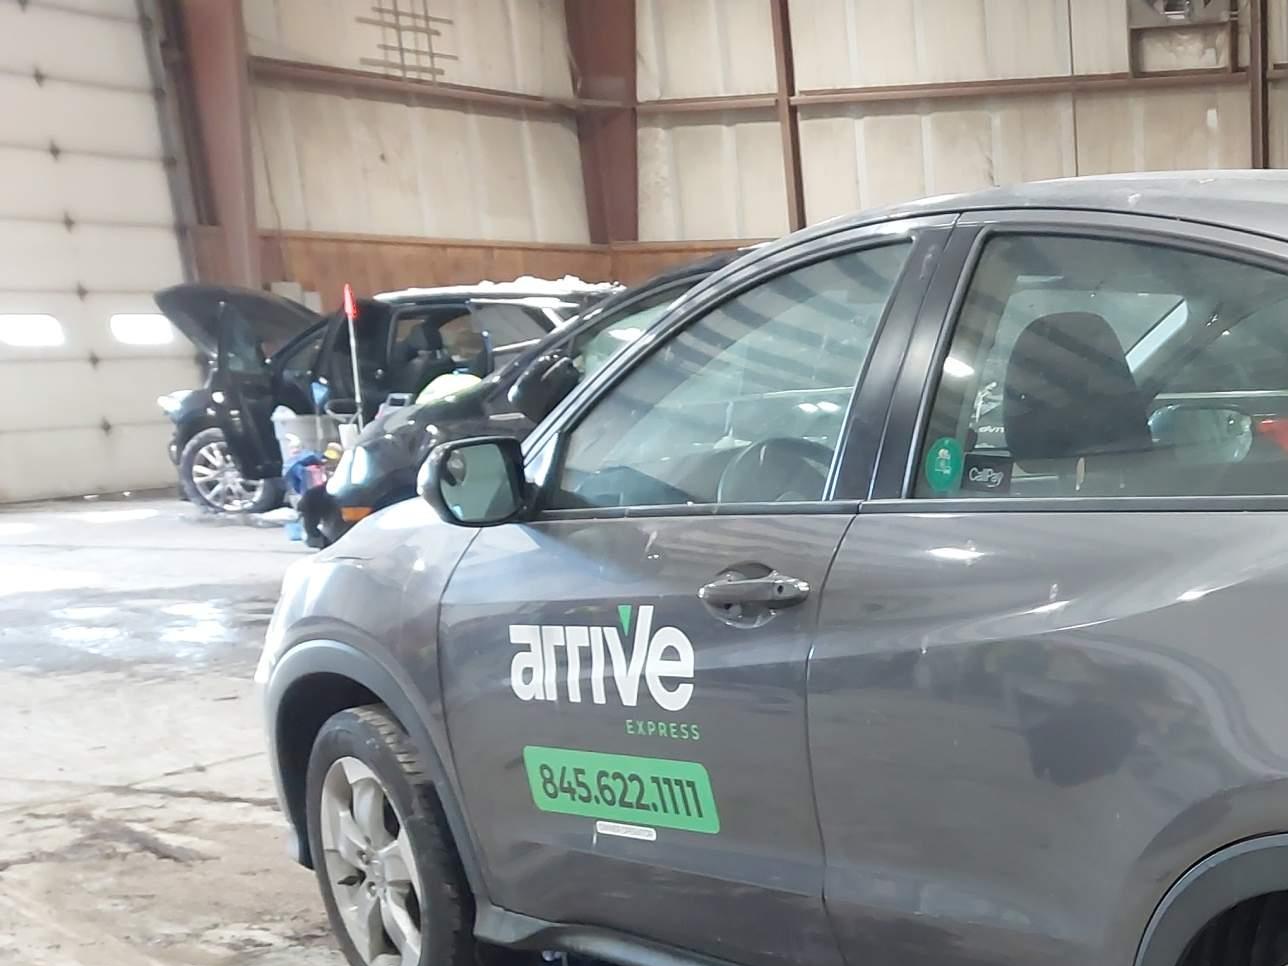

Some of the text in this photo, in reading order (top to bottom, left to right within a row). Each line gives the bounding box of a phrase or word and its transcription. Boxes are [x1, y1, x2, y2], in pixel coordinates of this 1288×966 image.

[508, 605, 695, 711] arrive
[625, 719, 700, 740] EXPRESS
[539, 763, 703, 818] 845.622.1111
